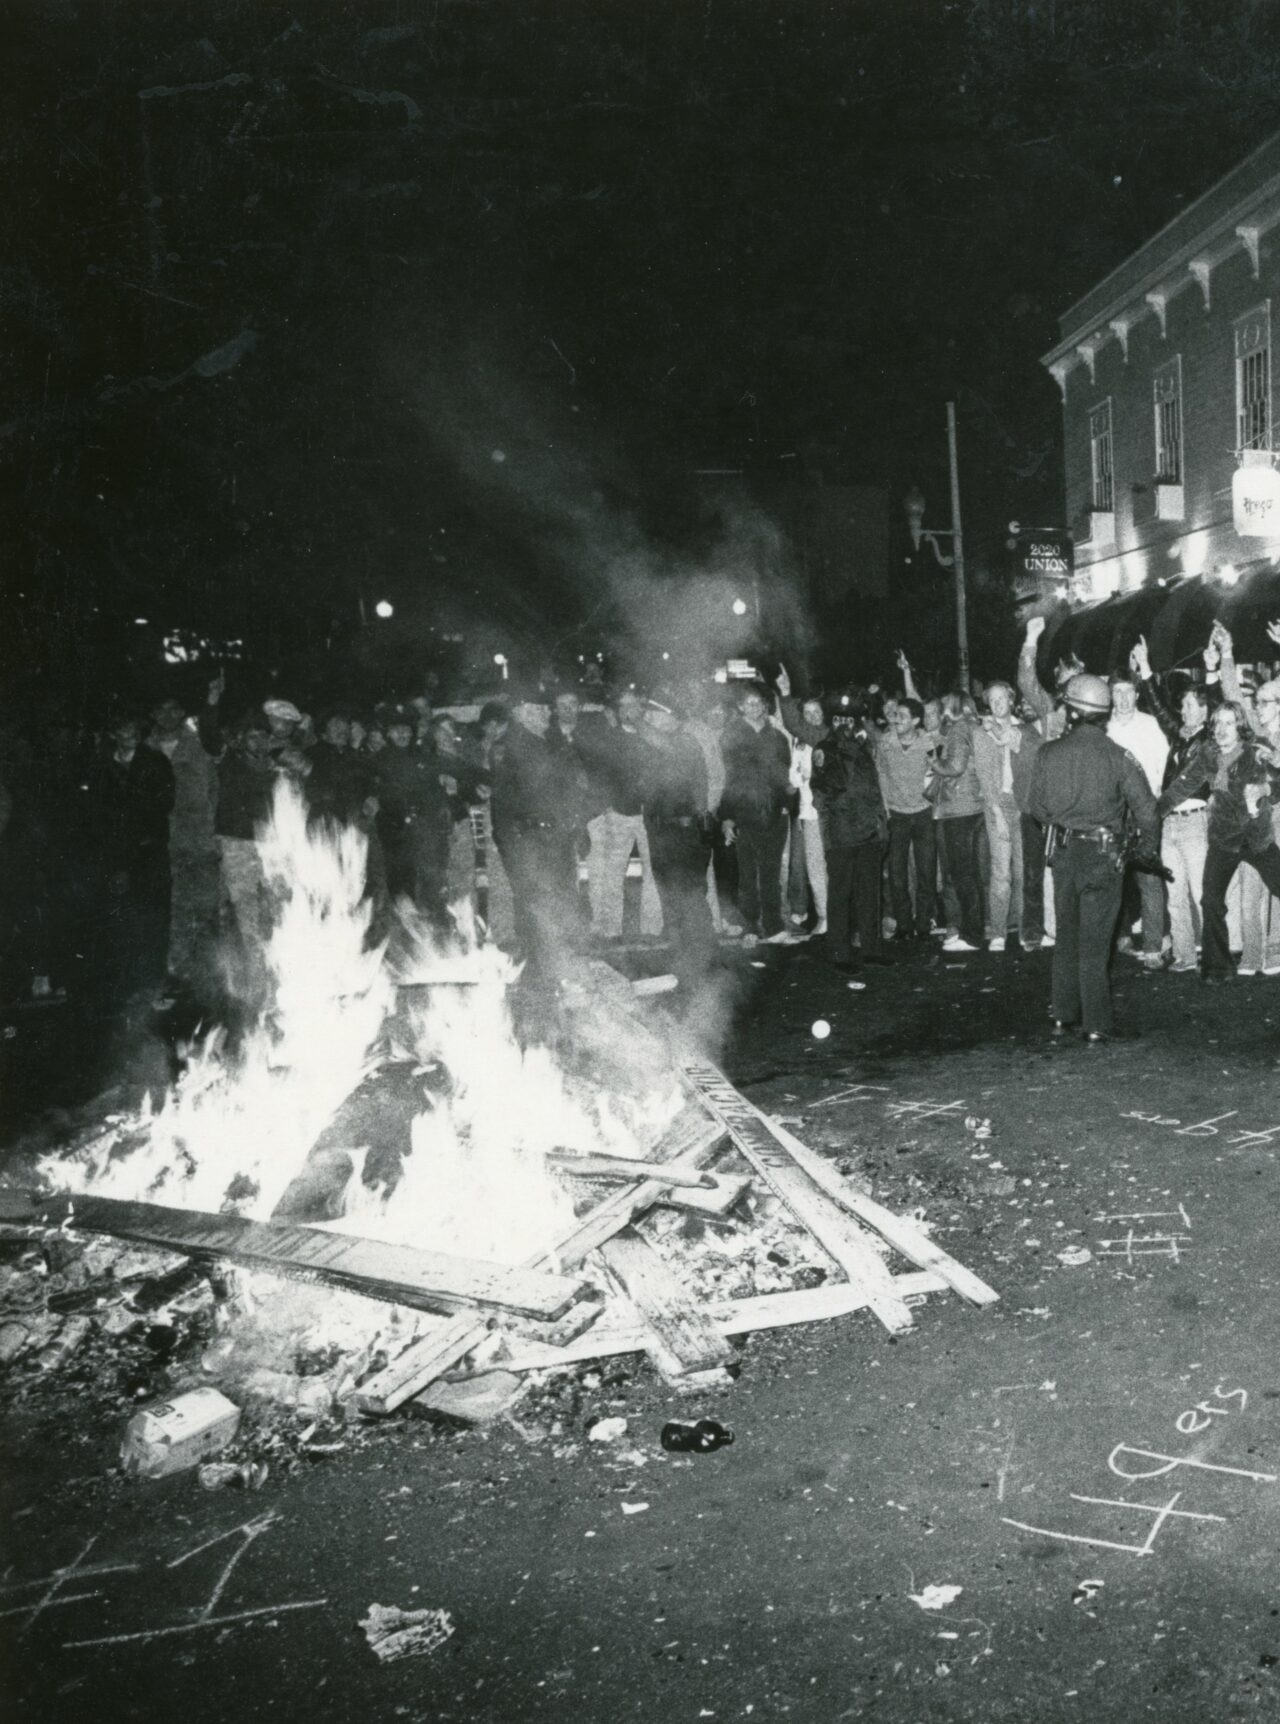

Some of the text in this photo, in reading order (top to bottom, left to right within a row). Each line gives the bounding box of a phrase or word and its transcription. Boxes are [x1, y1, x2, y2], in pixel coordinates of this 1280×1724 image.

[1030, 543, 1060, 556] 2020
[1024, 558, 1068, 572] UNION
[1001, 1383, 1277, 1556] 49ers
